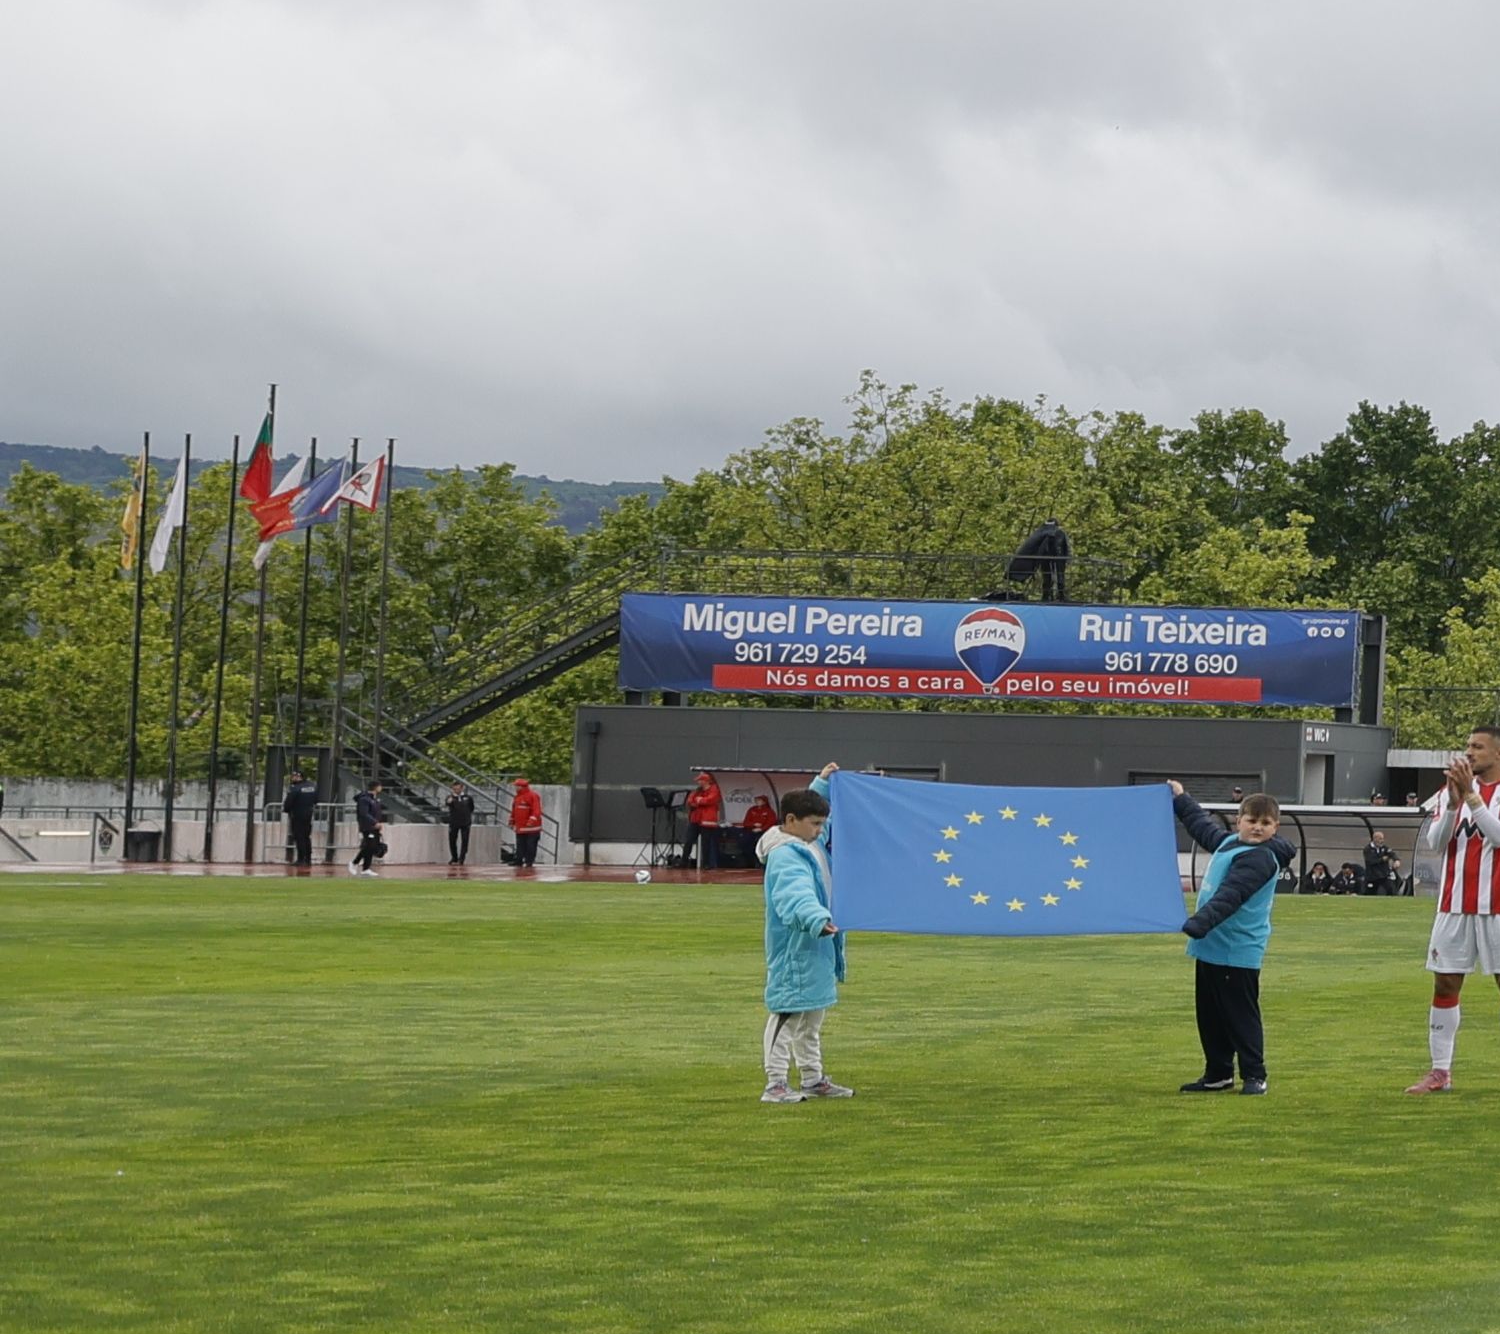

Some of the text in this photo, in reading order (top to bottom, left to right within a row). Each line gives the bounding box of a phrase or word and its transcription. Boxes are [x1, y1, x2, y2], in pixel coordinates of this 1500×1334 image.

[683, 603, 922, 639] Miguel Pereira
[1079, 614, 1267, 646] Rui Teixeira
[964, 628, 1017, 643] RE/MAX
[734, 642, 866, 665] 961 729 254
[1105, 652, 1238, 674] 961 778 690
[766, 670, 1188, 696] Nós damos a cara pelo seu imóvel!
[1314, 728, 1325, 742] WC
